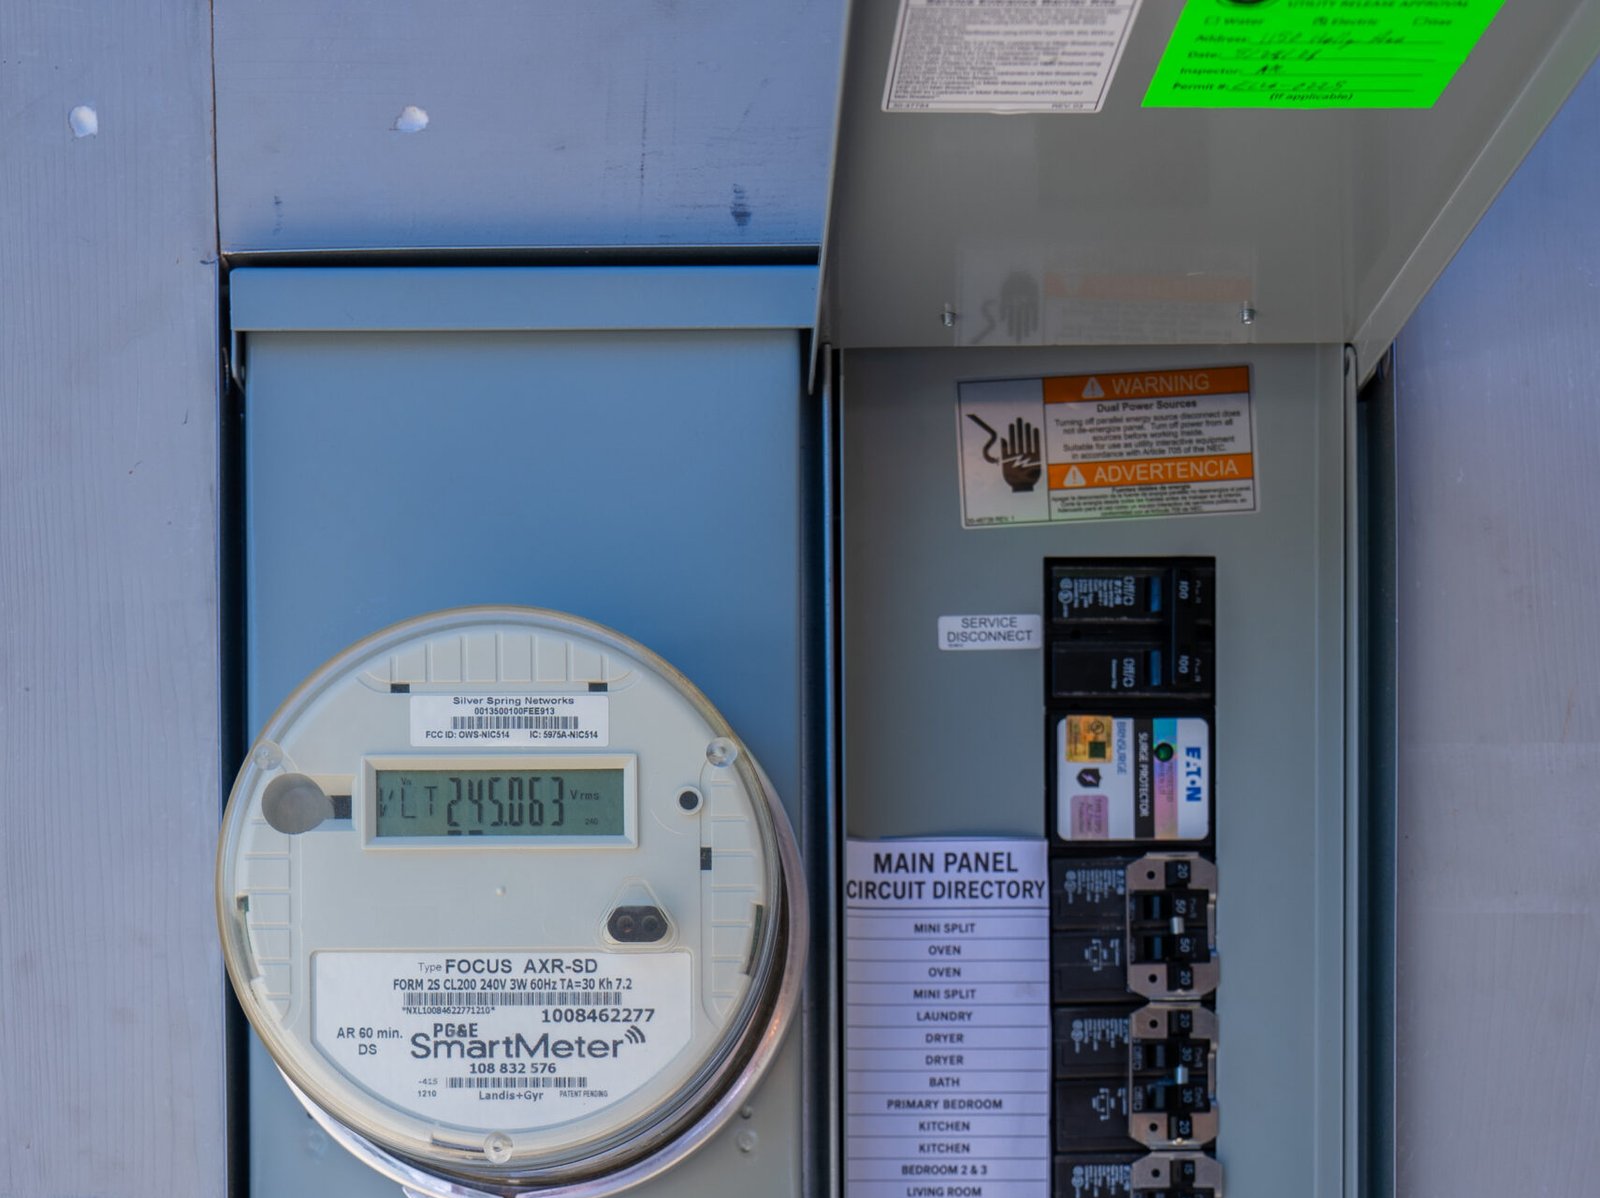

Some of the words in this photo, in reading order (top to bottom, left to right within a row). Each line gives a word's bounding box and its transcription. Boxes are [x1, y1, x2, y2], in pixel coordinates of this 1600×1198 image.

[1112, 374, 1210, 395] WARNING
[1096, 403, 1120, 413] Dual
[1121, 401, 1153, 412] Power
[1156, 399, 1197, 410] Sources
[1096, 415, 1123, 425] parallel
[1125, 415, 1151, 424] energy
[1180, 411, 1220, 420] disconnect
[1094, 460, 1239, 483] ADVERTENCIA
[1179, 580, 1189, 599] 100
[961, 616, 1017, 628] SERVICE
[947, 630, 1033, 643] DISCONNECT
[1179, 655, 1189, 674] 100
[453, 697, 485, 705] Silver
[486, 697, 521, 707] Spring
[525, 697, 575, 705] Networks
[474, 707, 555, 716] 0013500100FEE913
[425, 731, 444, 739] FCC
[445, 731, 457, 739] ID:
[458, 731, 510, 739] OWS-NIC514
[529, 731, 541, 739] IC:
[543, 731, 598, 739] 5975A-NIC514
[1139, 732, 1149, 762] SURGE
[1139, 763, 1149, 817] PROTECTOR
[447, 777, 564, 827] 245.063
[873, 852, 934, 874] MAIN
[943, 852, 1018, 873] PANEL
[1177, 864, 1188, 879] 20
[846, 880, 925, 900] CIRCUIT
[933, 880, 1046, 899] DIRECTORY
[1175, 899, 1187, 914] 50
[914, 923, 940, 934] MINI
[944, 923, 976, 934] SPLIT
[928, 945, 961, 955] OVEN
[1180, 937, 1190, 953] 50
[417, 961, 442, 974] Type
[445, 959, 513, 974] FOCUS
[523, 959, 598, 974] AXR-SD
[928, 967, 961, 977] OVEN
[1180, 970, 1191, 986] 20
[393, 978, 424, 991] FORM
[427, 978, 440, 991] 2S
[443, 978, 477, 991] CL200
[480, 978, 507, 991] 240V
[509, 978, 527, 991] 3W
[530, 978, 557, 991] 60Hz
[559, 978, 595, 991] TA=30
[599, 978, 613, 991] Kh
[615, 978, 632, 991] 7.2
[913, 989, 940, 999] MINI
[944, 989, 976, 999] SPLIT
[541, 1008, 655, 1024] 1008462277
[916, 1011, 973, 1022] LAUNDRY
[1180, 1014, 1190, 1028] 20
[336, 1027, 356, 1039] AR
[359, 1027, 374, 1039] 60
[376, 1027, 404, 1039] min.
[433, 1023, 479, 1038] PG&E
[925, 1033, 964, 1043] DRYER
[358, 1044, 377, 1055] DS
[410, 1032, 624, 1059] SmartMeter
[925, 1055, 964, 1065] DRYER
[1182, 1047, 1192, 1062] 30
[469, 1063, 497, 1074] 108
[499, 1063, 526, 1074] 832
[530, 1063, 557, 1074] 576
[929, 1077, 960, 1087] BATH
[417, 1090, 437, 1098] 1210
[479, 1091, 544, 1102] Landis+Gyr
[559, 1090, 582, 1098] PATENT
[1183, 1089, 1193, 1103] 30
[887, 1099, 939, 1110] PRIMARY
[943, 1099, 1003, 1110] BEDROOM
[918, 1121, 970, 1131] KITCHEN
[1179, 1120, 1190, 1135] 20
[918, 1143, 970, 1154] KITCHEN
[901, 1165, 958, 1175] BEDROOM
[961, 1165, 968, 1175] 2
[970, 1165, 978, 1175] &
[980, 1165, 987, 1175] 3
[1184, 1163, 1194, 1175] 15
[906, 1187, 944, 1197] LIVING
[947, 1187, 982, 1197] ROOM
